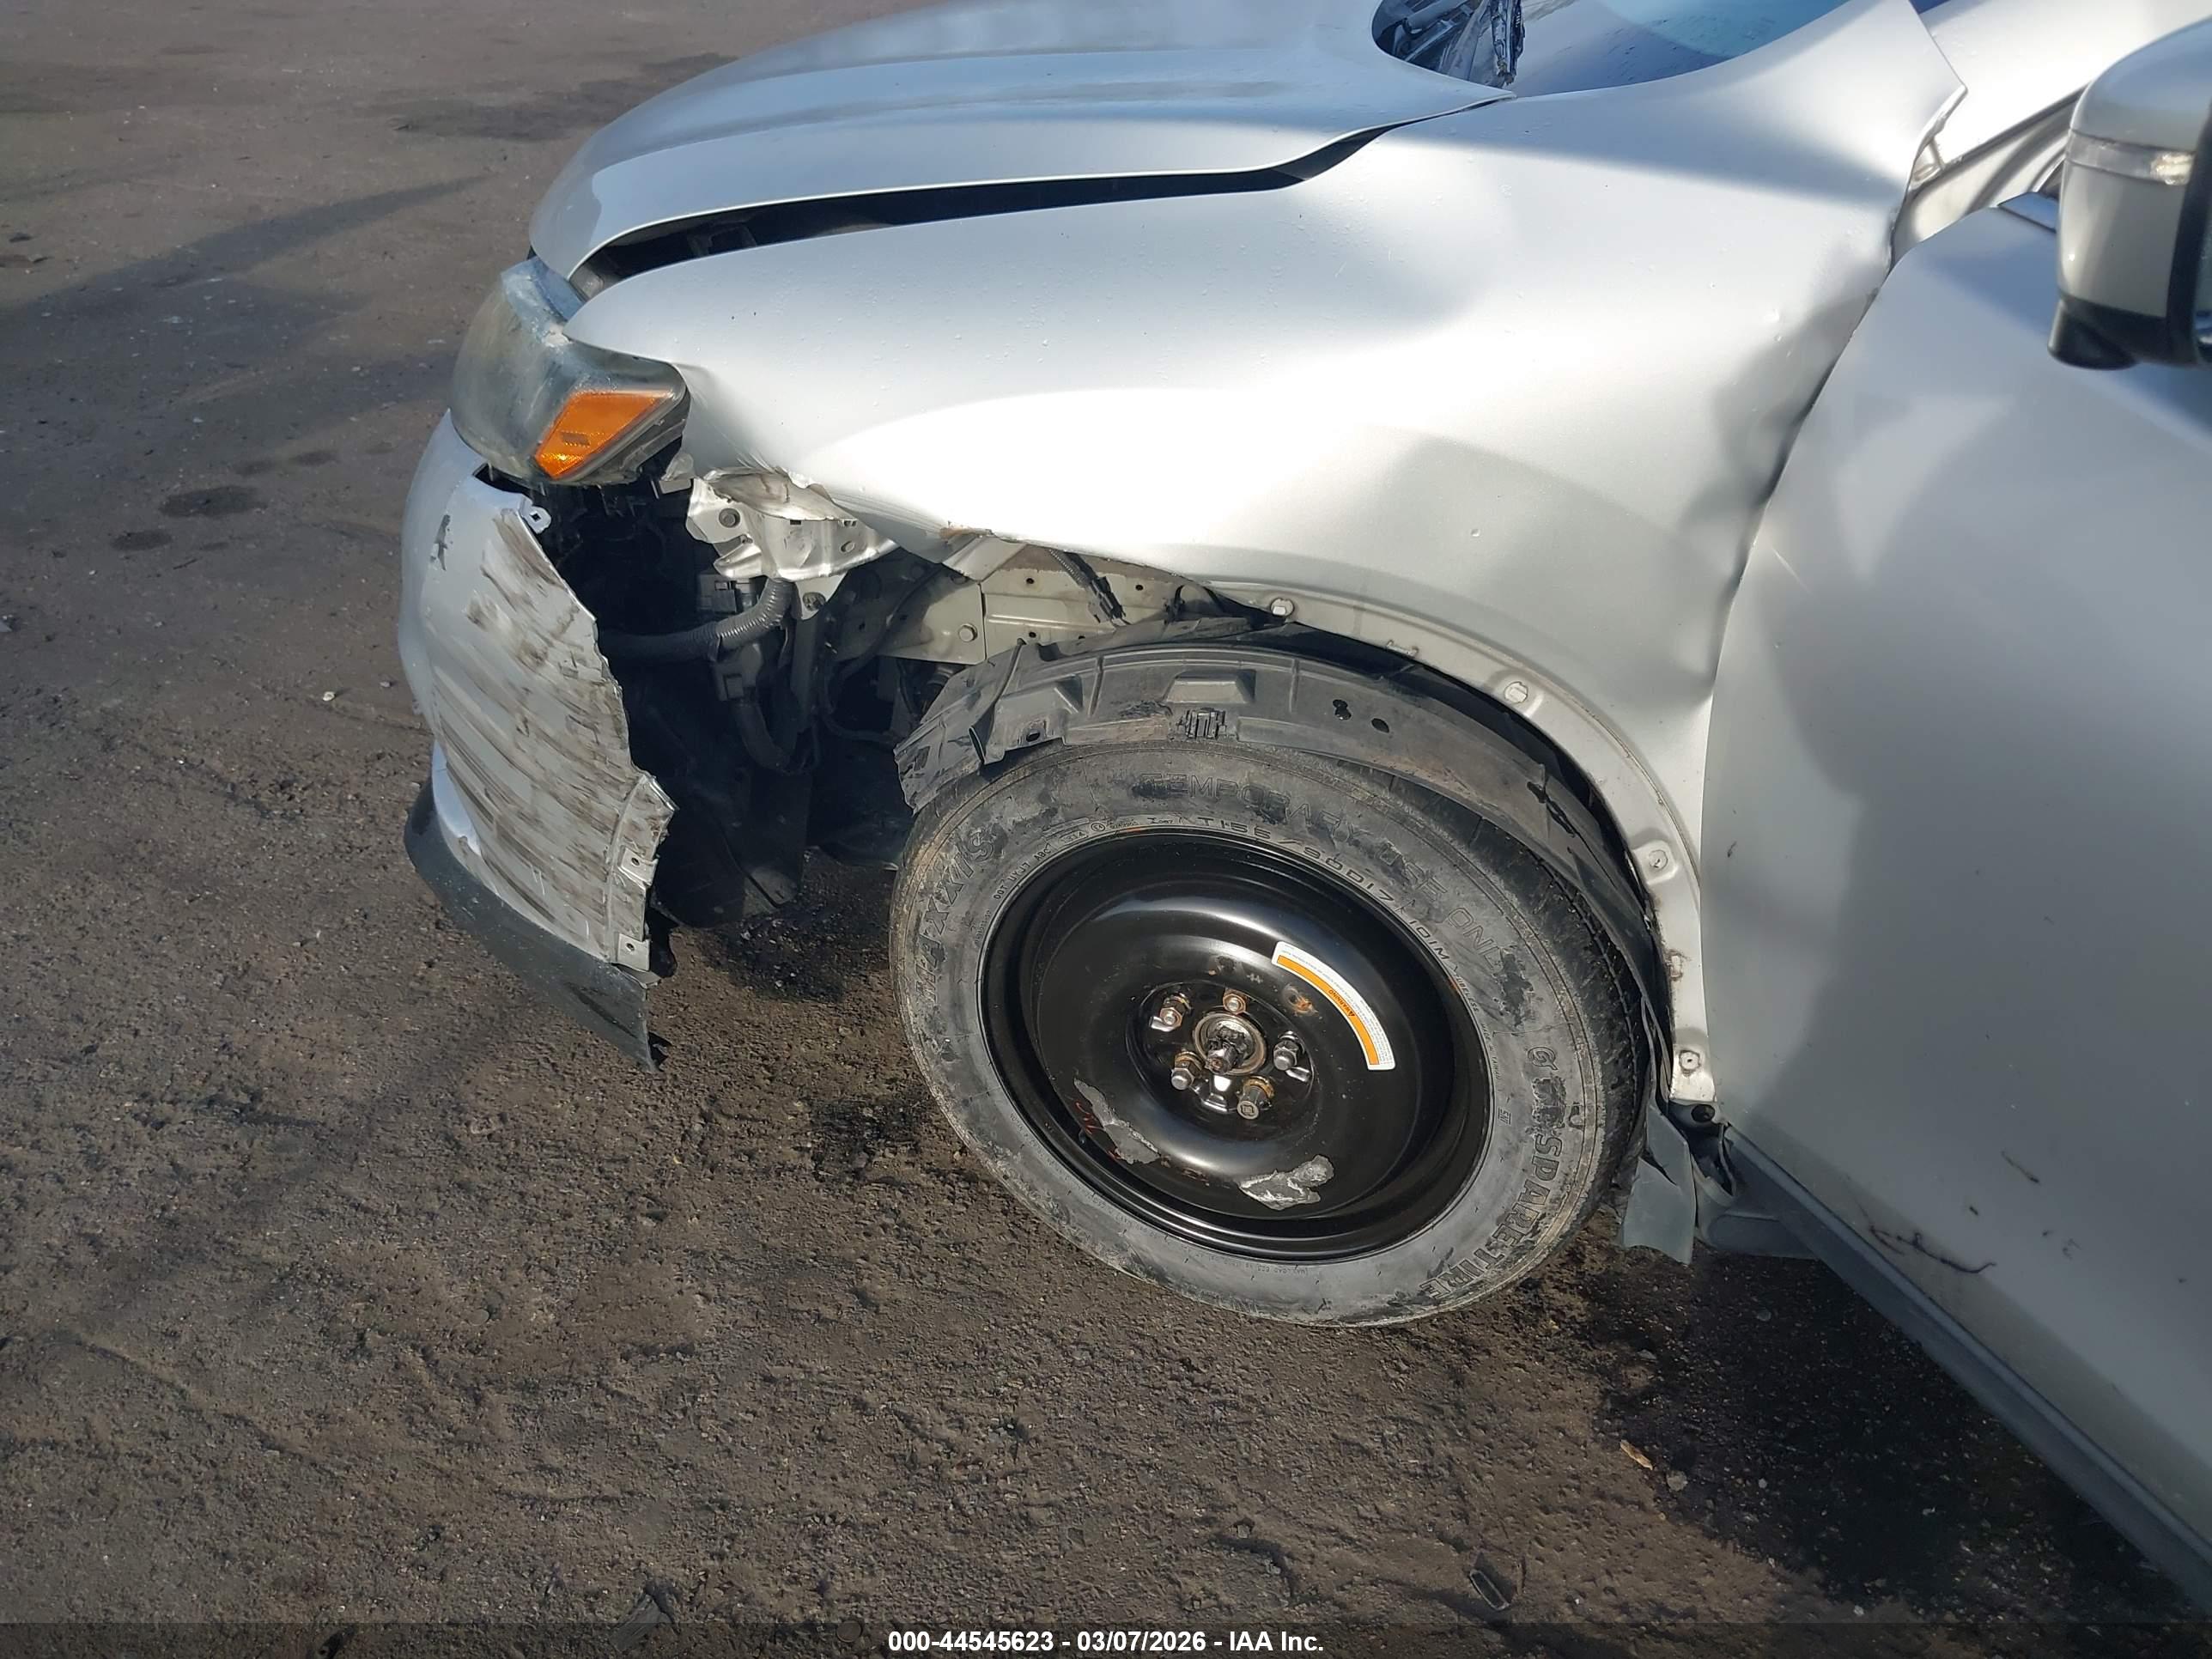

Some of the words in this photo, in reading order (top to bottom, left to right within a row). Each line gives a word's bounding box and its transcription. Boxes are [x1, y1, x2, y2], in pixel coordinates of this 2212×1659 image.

[1034, 847, 1051, 861] ABC
[1379, 841, 1448, 902] USE
[916, 830, 994, 1003] MAXXIS
[1492, 1134, 1564, 1244] SPARE
[1419, 1248, 1504, 1299] TIRE
